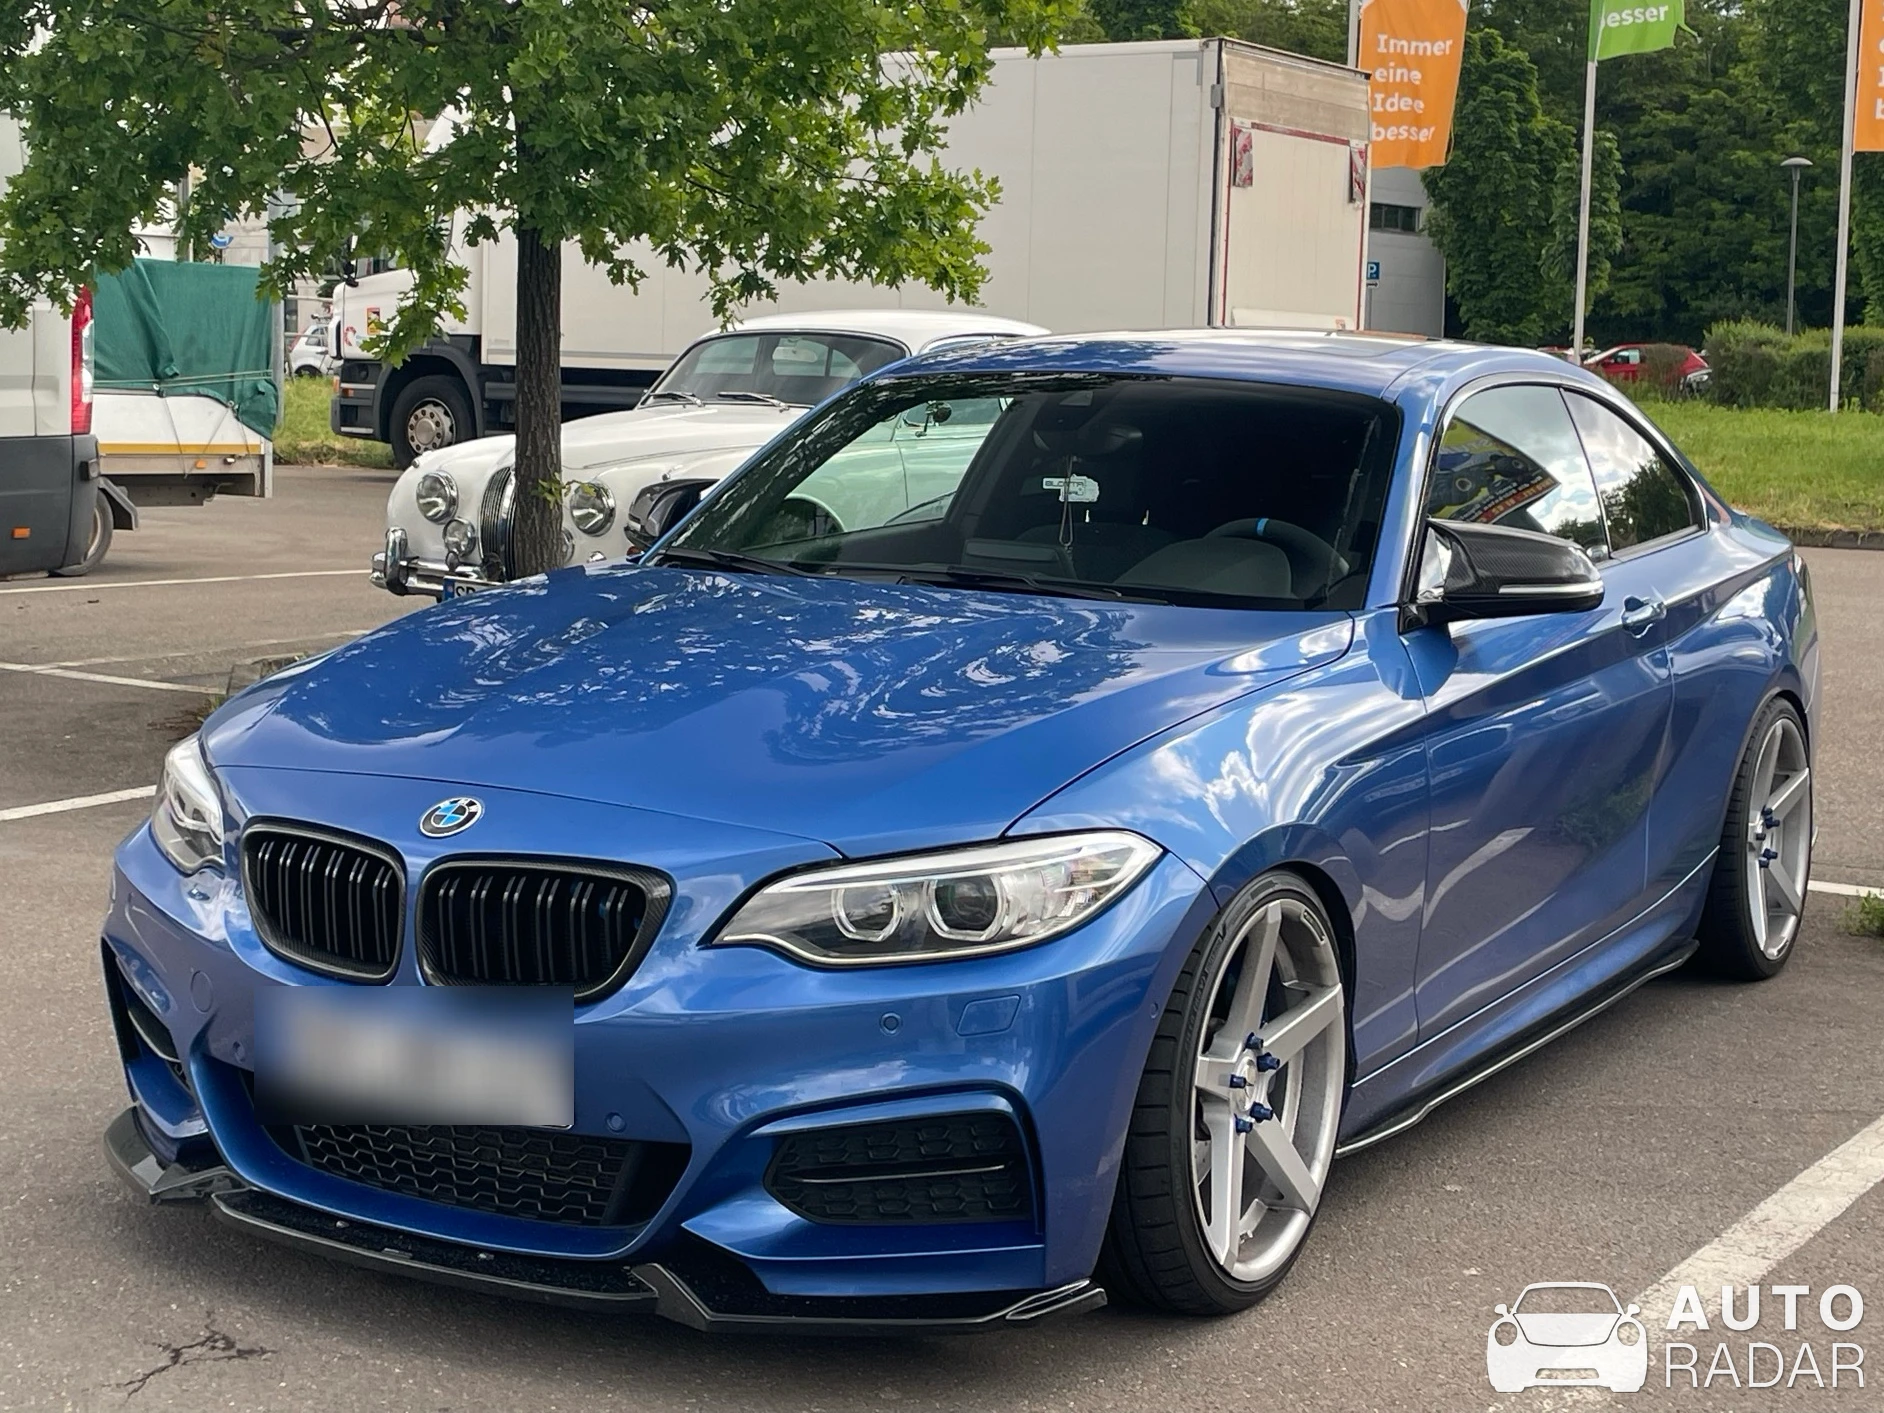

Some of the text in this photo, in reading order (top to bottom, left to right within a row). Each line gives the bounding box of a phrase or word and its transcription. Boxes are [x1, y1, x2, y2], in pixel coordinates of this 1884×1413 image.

[1601, 5, 1669, 29] esser
[1377, 33, 1453, 56] Immer
[1374, 62, 1422, 85] eine
[1372, 92, 1425, 114] Idee
[1371, 121, 1436, 142] besser
[1367, 264, 1377, 278] P
